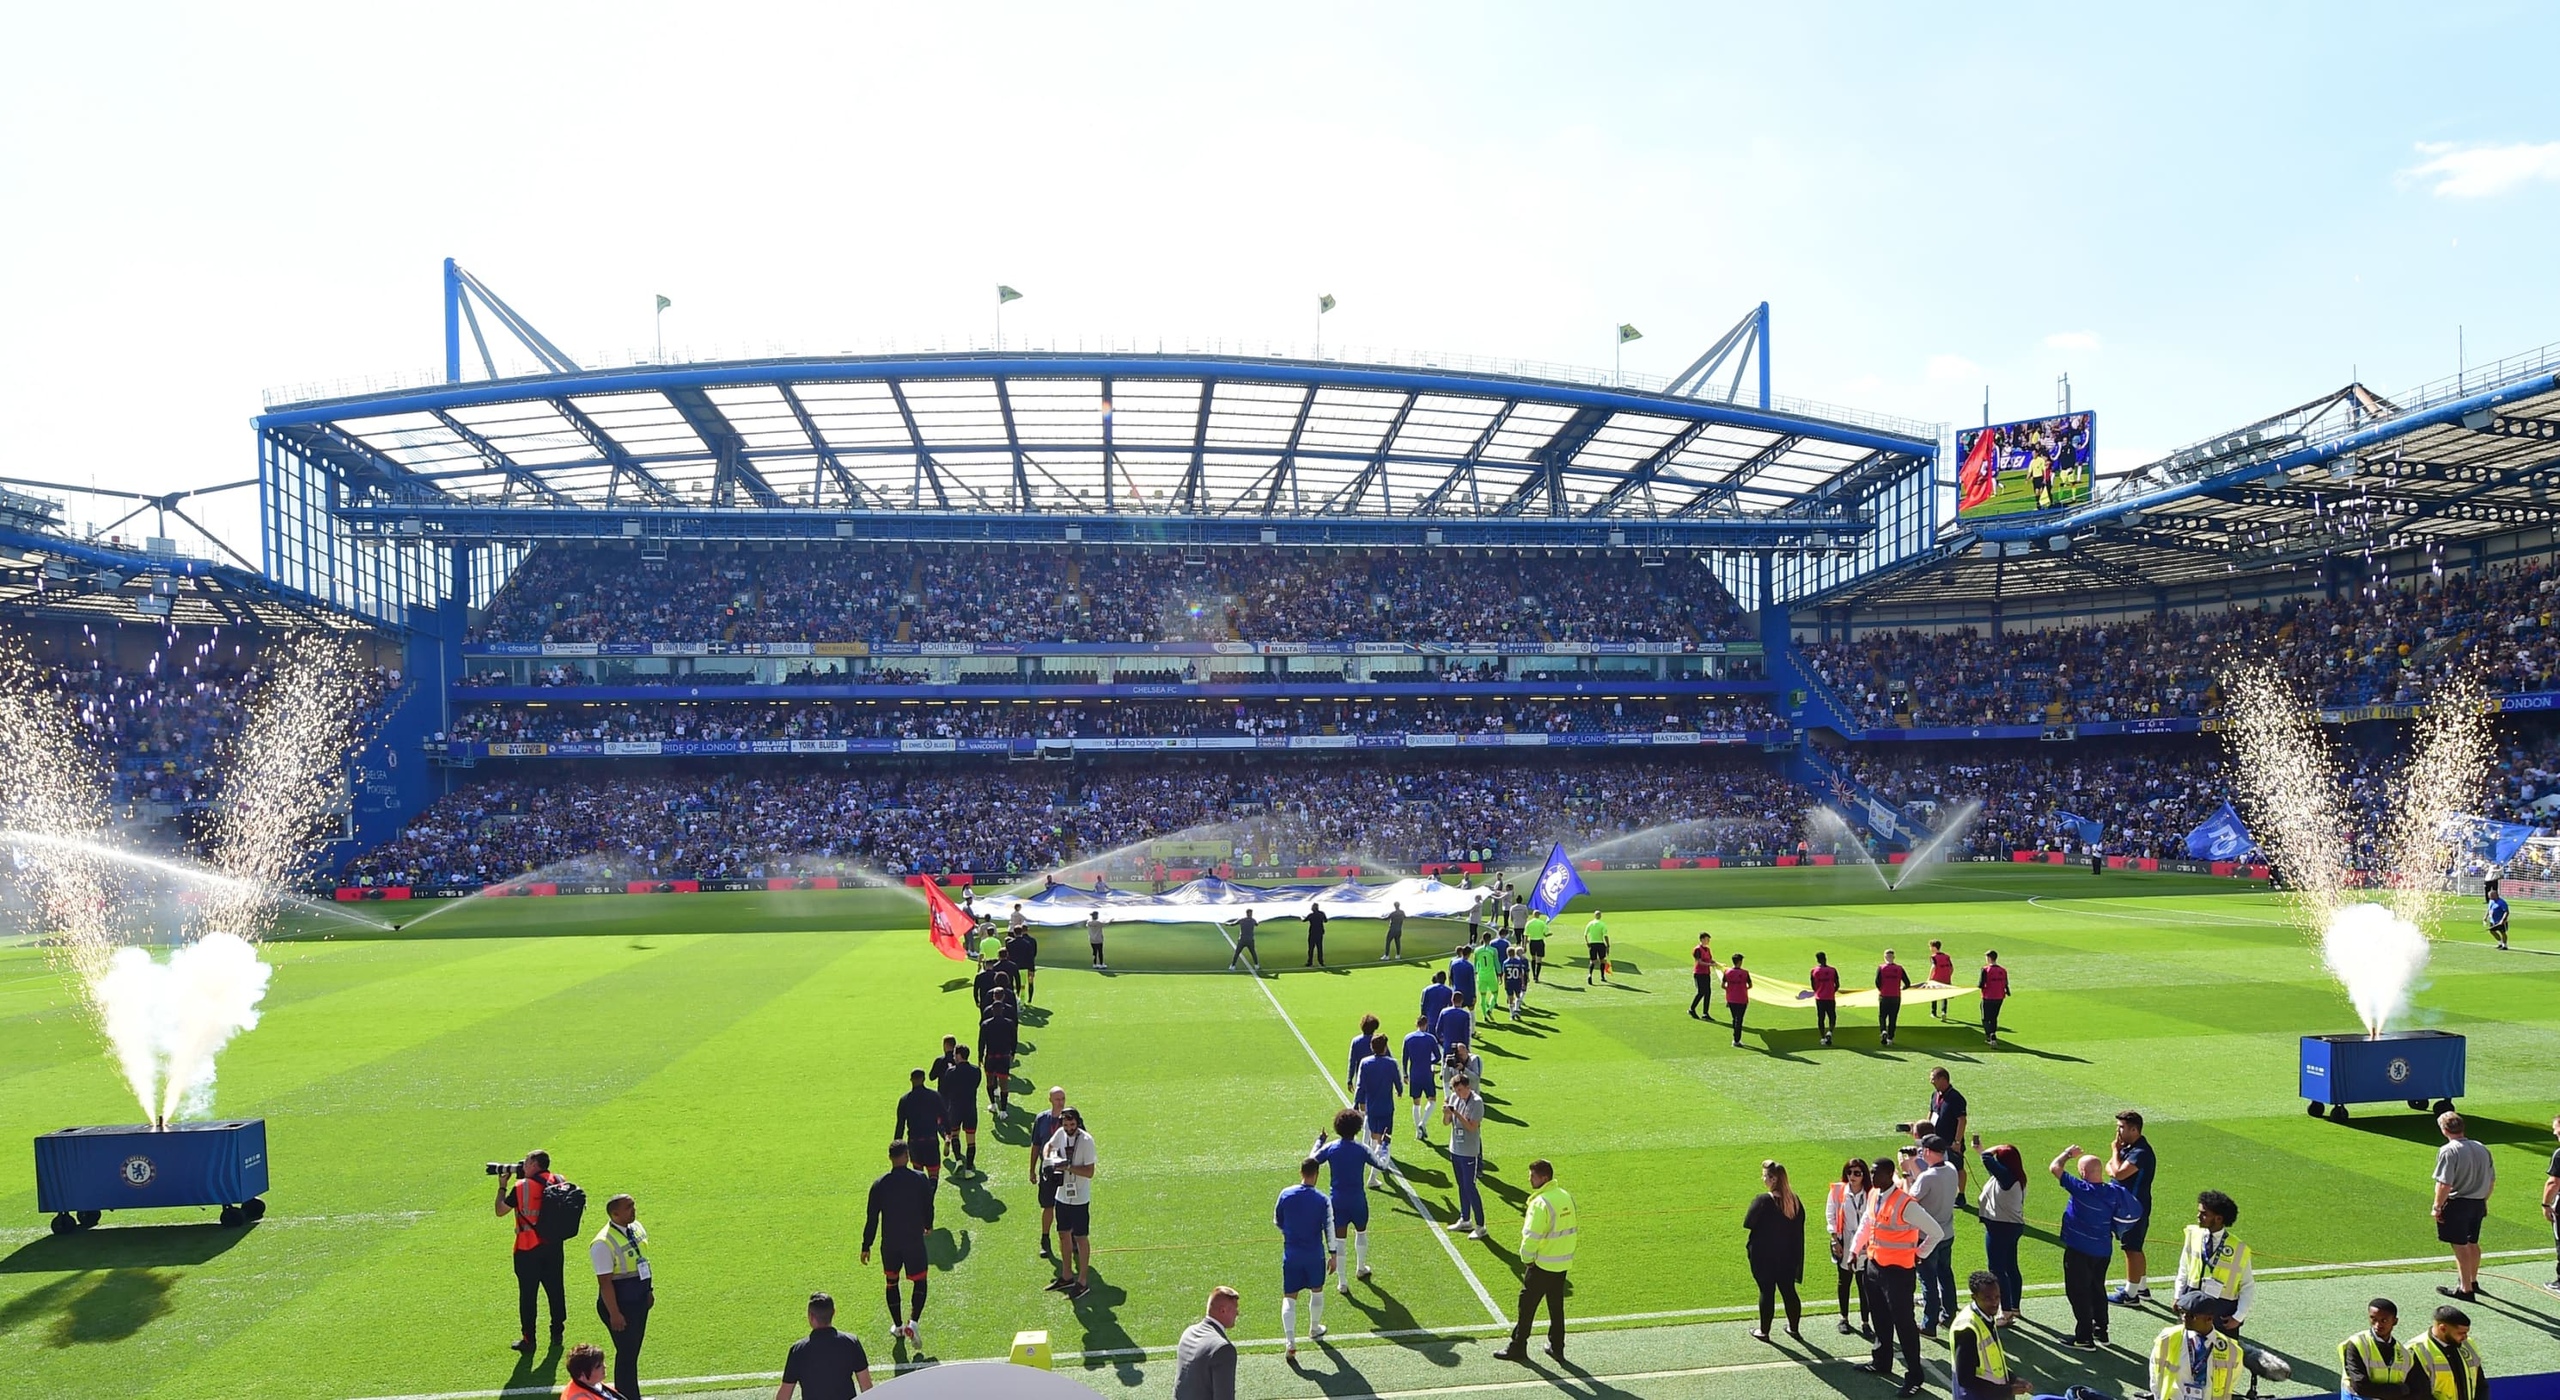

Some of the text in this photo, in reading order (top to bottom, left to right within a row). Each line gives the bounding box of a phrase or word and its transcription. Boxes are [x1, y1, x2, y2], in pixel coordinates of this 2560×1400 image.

[1133, 686, 1177, 694] CHELSEA FC
[2500, 696, 2552, 710] LONDON
[1136, 739, 1163, 747] bridges
[1483, 956, 1488, 967] 1
[1506, 968, 1519, 979] 30
